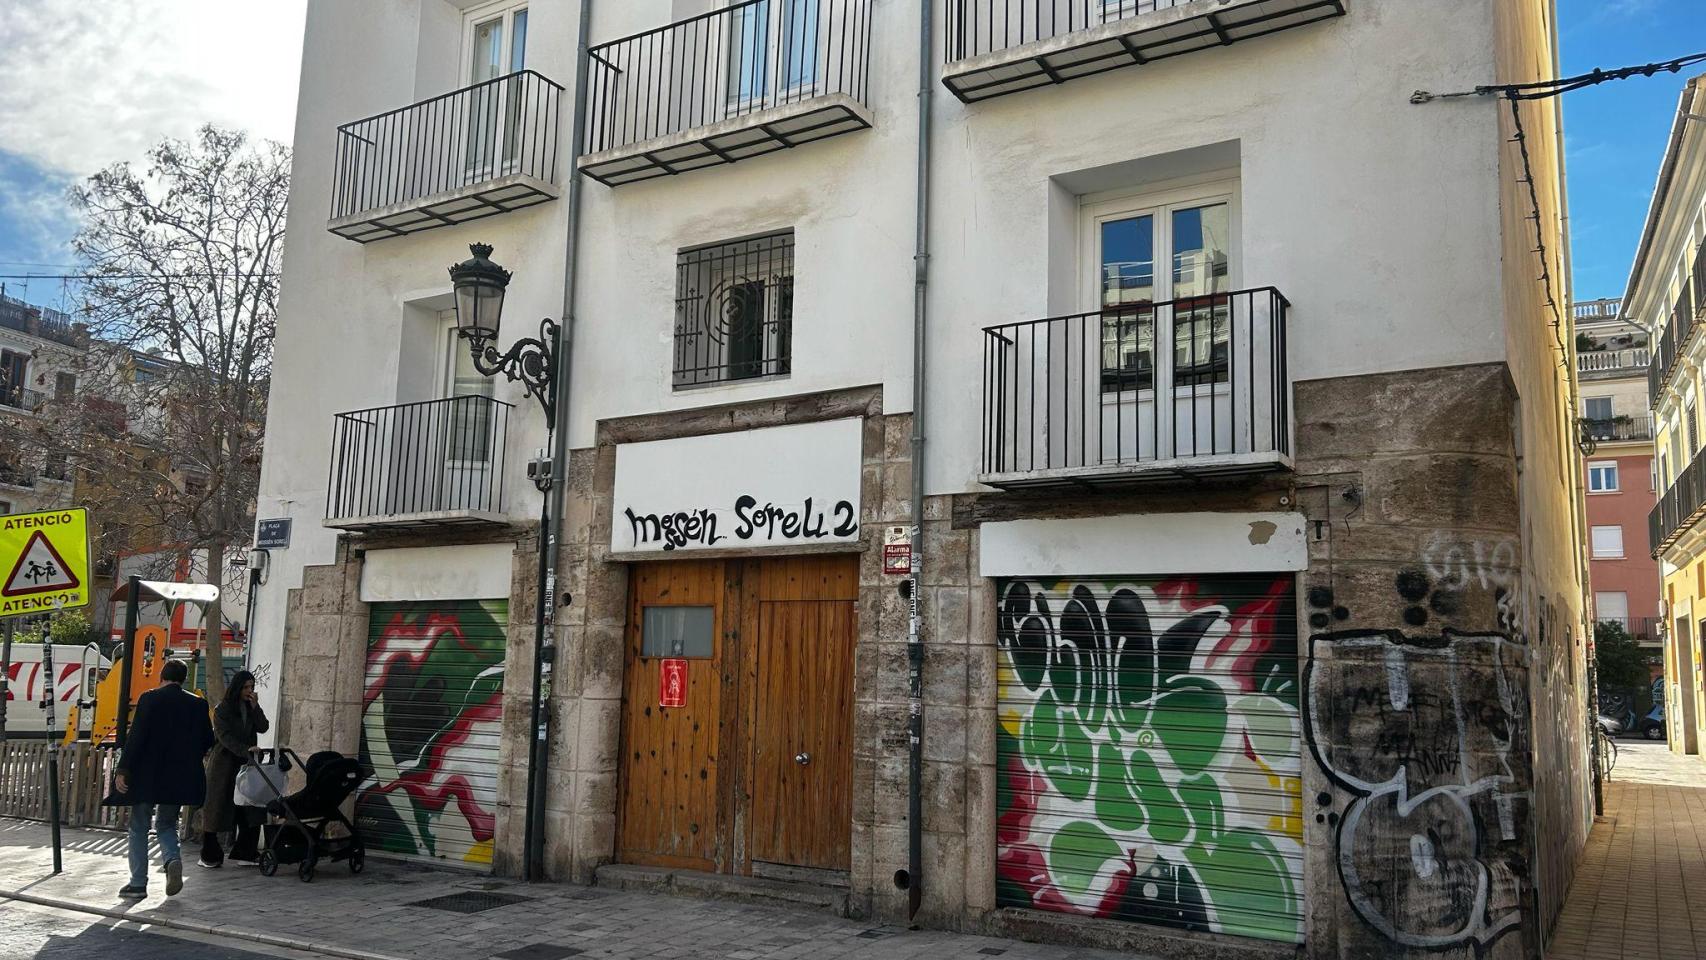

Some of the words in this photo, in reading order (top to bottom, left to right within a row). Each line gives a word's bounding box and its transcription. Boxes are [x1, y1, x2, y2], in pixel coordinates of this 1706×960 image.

[4, 512, 72, 530] ATENCIÓ
[834, 500, 858, 537] 2
[3, 592, 69, 612] ATENCÓ
